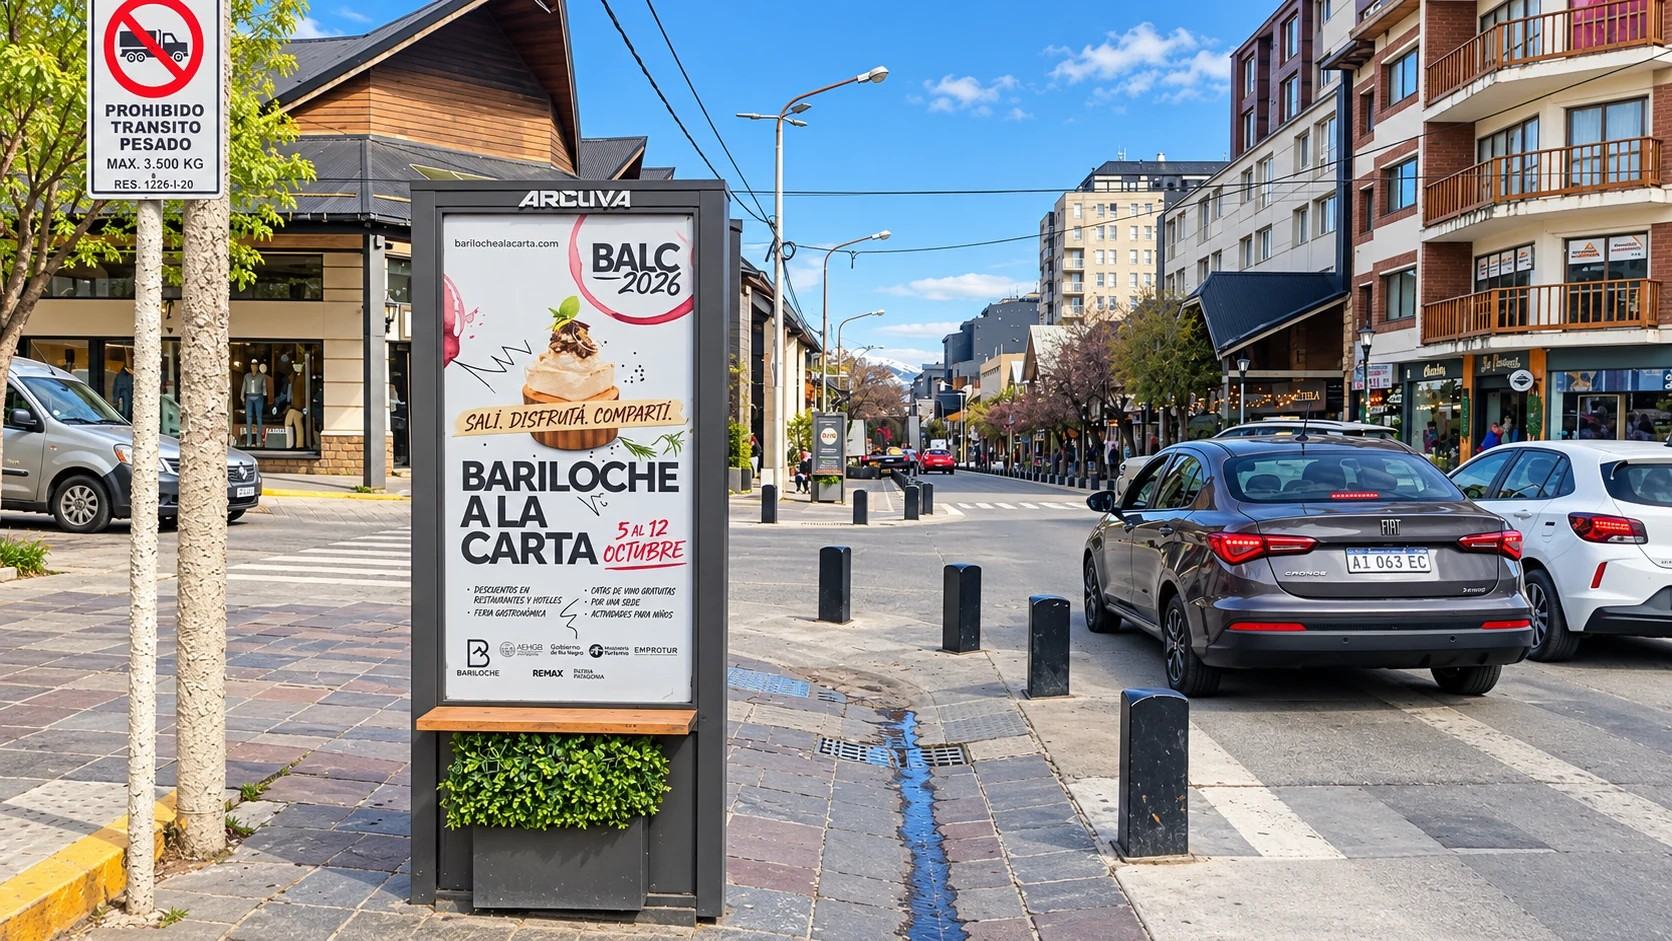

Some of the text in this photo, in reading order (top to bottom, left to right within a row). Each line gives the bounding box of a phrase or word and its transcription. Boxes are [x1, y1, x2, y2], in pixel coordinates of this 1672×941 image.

[106, 104, 204, 117] PROHIBIDO
[111, 121, 201, 133] TRANSITO
[120, 138, 191, 150] PESADO
[107, 158, 203, 169] MAX. 3.500 KG
[114, 180, 193, 189] RES. 1226-I-20
[454, 239, 559, 248] barilochealacarta.com
[593, 243, 680, 272] BALC
[618, 272, 681, 296] 2026
[509, 404, 588, 428] DISFRUTÁ.
[594, 400, 672, 424] COMPARTÍ.
[462, 461, 679, 492] BARILOCHE
[460, 496, 548, 528] A LA
[616, 519, 669, 539] 5 AL 12
[1381, 519, 1401, 536] FIAT
[461, 531, 598, 564] CARTA
[603, 541, 686, 563] OCTUBRE
[1376, 556, 1402, 569] 063
[1408, 556, 1426, 568] EC
[613, 587, 622, 595] DE
[624, 587, 639, 595] VINO
[641, 587, 676, 595] GRATUITAS
[474, 596, 562, 604] RESTAURANTES Y HOTELES
[591, 598, 605, 606] POR
[591, 610, 632, 618] ACTIVIDADES
[634, 610, 650, 618] PARA
